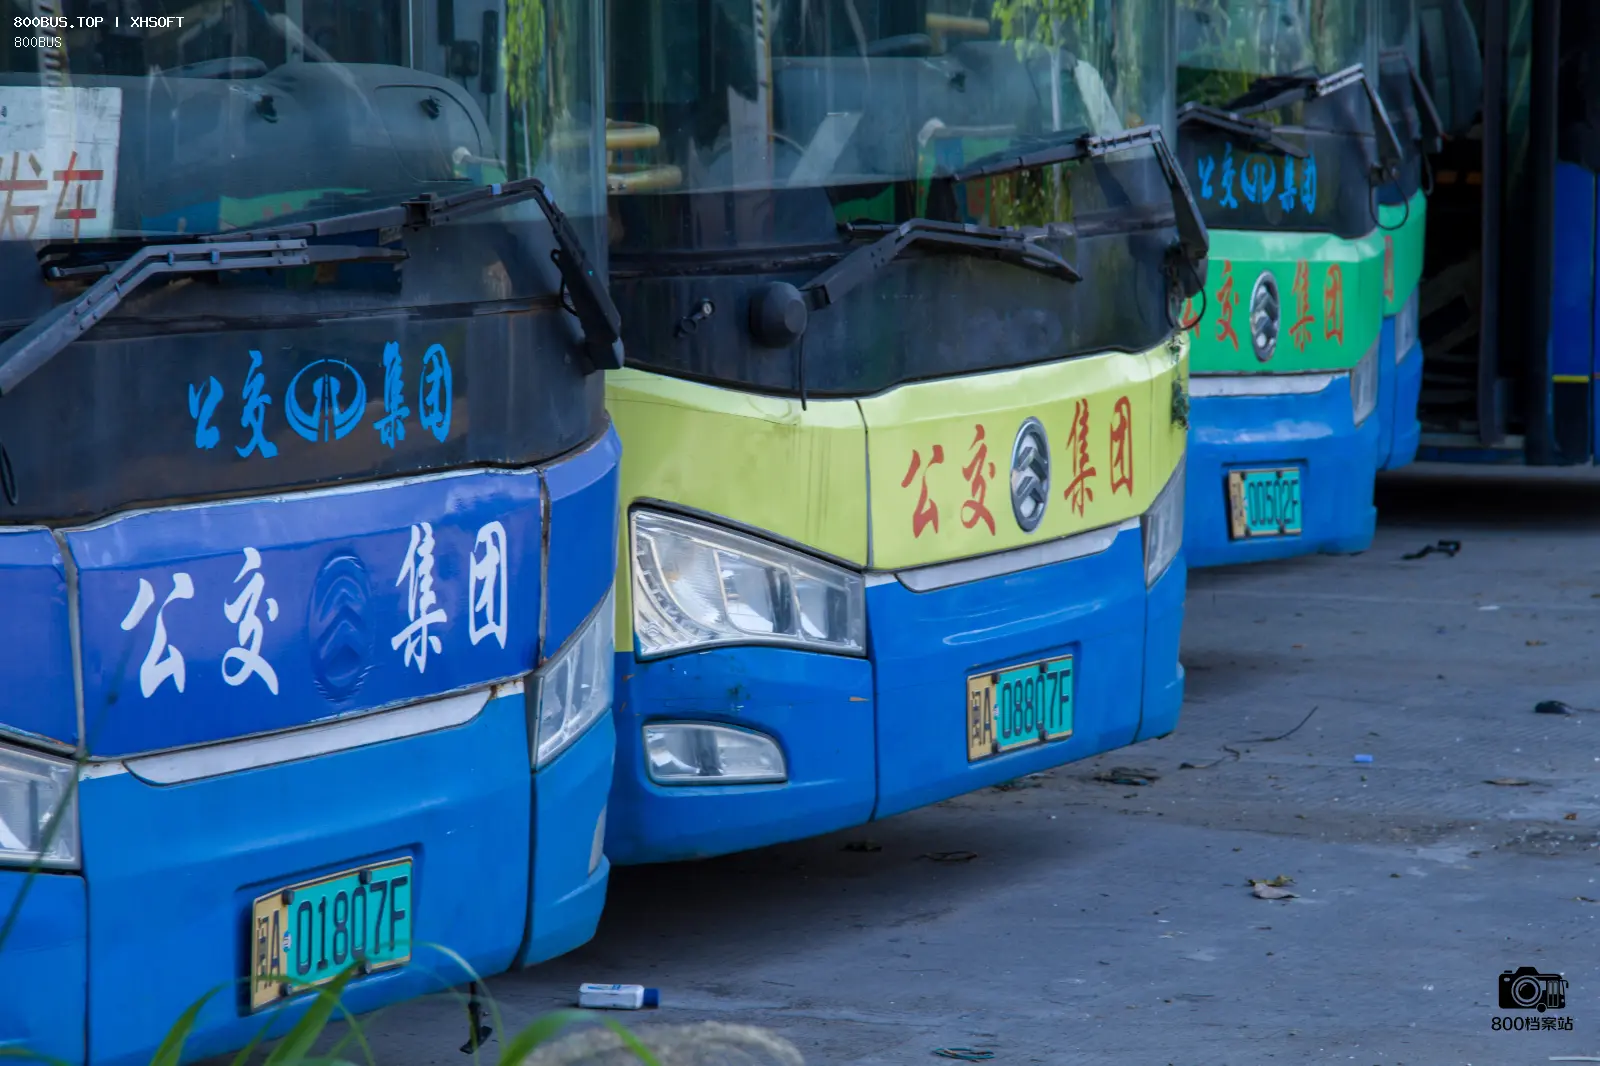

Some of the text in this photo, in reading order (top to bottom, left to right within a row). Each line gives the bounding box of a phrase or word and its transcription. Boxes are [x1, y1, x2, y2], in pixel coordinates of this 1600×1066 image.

[1289, 257, 1343, 353] 集团
[188, 340, 453, 459] 公交 集团
[901, 395, 1134, 539] 公交 集团
[120, 520, 508, 699] 公交 集团
[1002, 668, 1071, 739] 08807F
[296, 875, 408, 976] 01807F
